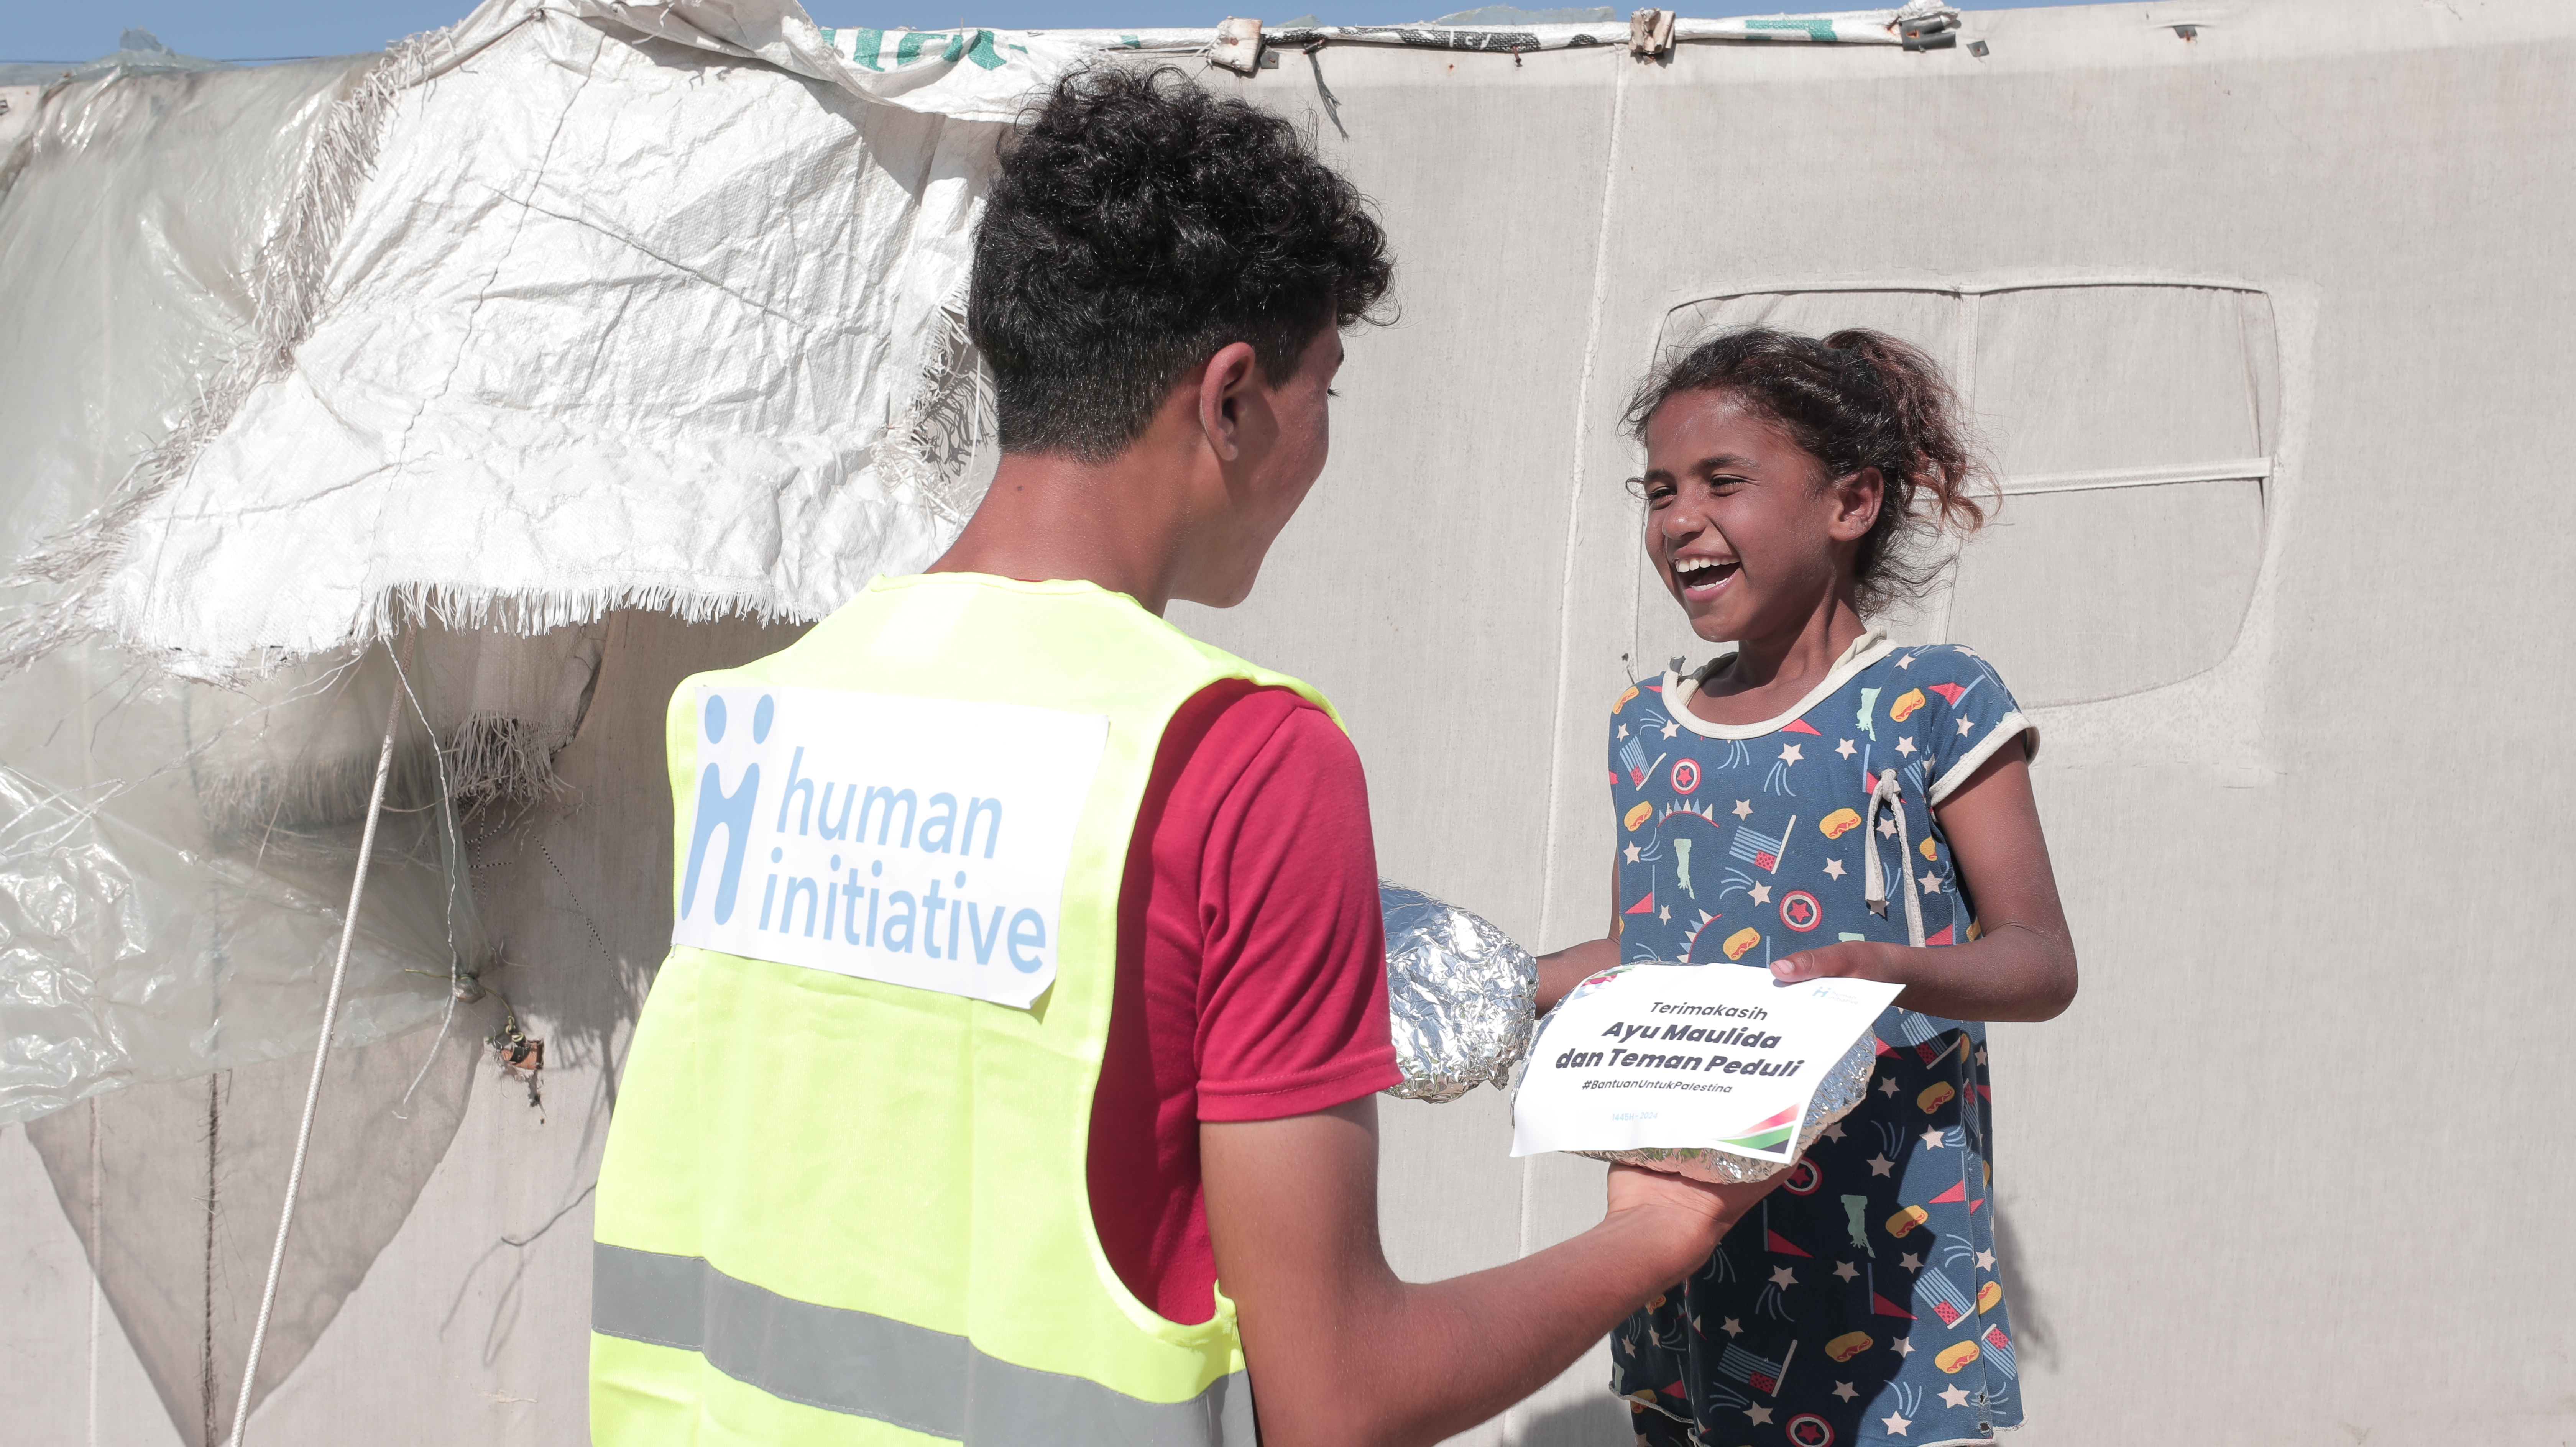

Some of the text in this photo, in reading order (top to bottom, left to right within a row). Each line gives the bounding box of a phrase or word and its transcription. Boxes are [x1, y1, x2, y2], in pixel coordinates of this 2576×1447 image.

[775, 746, 1003, 859] human
[758, 846, 1046, 974] initiative
[1827, 996, 1859, 1004] initiative
[1831, 991, 1857, 999] human
[1650, 1002, 1768, 1020] Terimakasih
[1601, 1022, 1782, 1049] Ayu Maulida
[1555, 1048, 1805, 1077] dan Teman Peduli
[1582, 1079, 1733, 1093] #BantuanUntukPalestina
